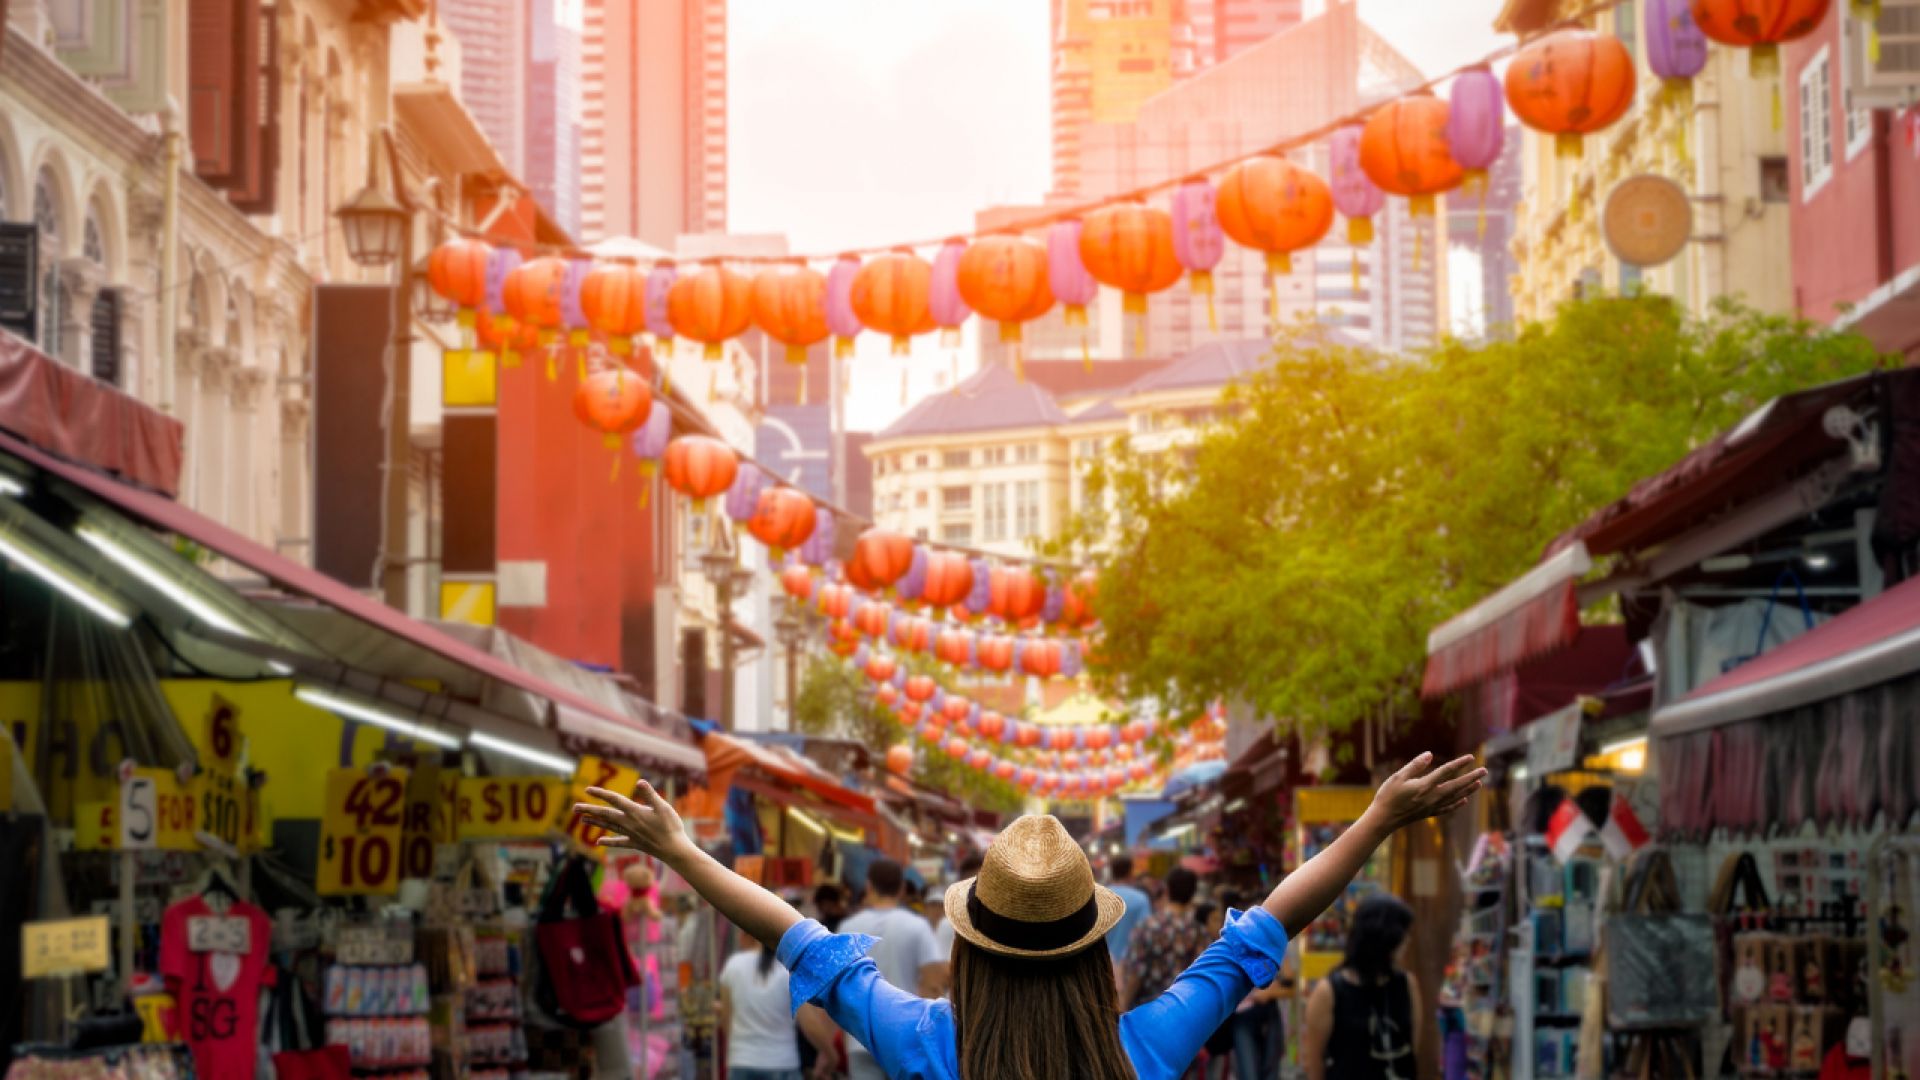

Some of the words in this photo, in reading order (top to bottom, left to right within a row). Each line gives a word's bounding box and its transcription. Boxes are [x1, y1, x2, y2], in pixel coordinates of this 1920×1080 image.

[212, 706, 232, 758] 6
[129, 781, 153, 841] 5
[159, 795, 195, 832] FOR
[344, 778, 402, 828] 42
[404, 803, 431, 832] R
[482, 782, 547, 823] $10
[192, 997, 238, 1042] SG
